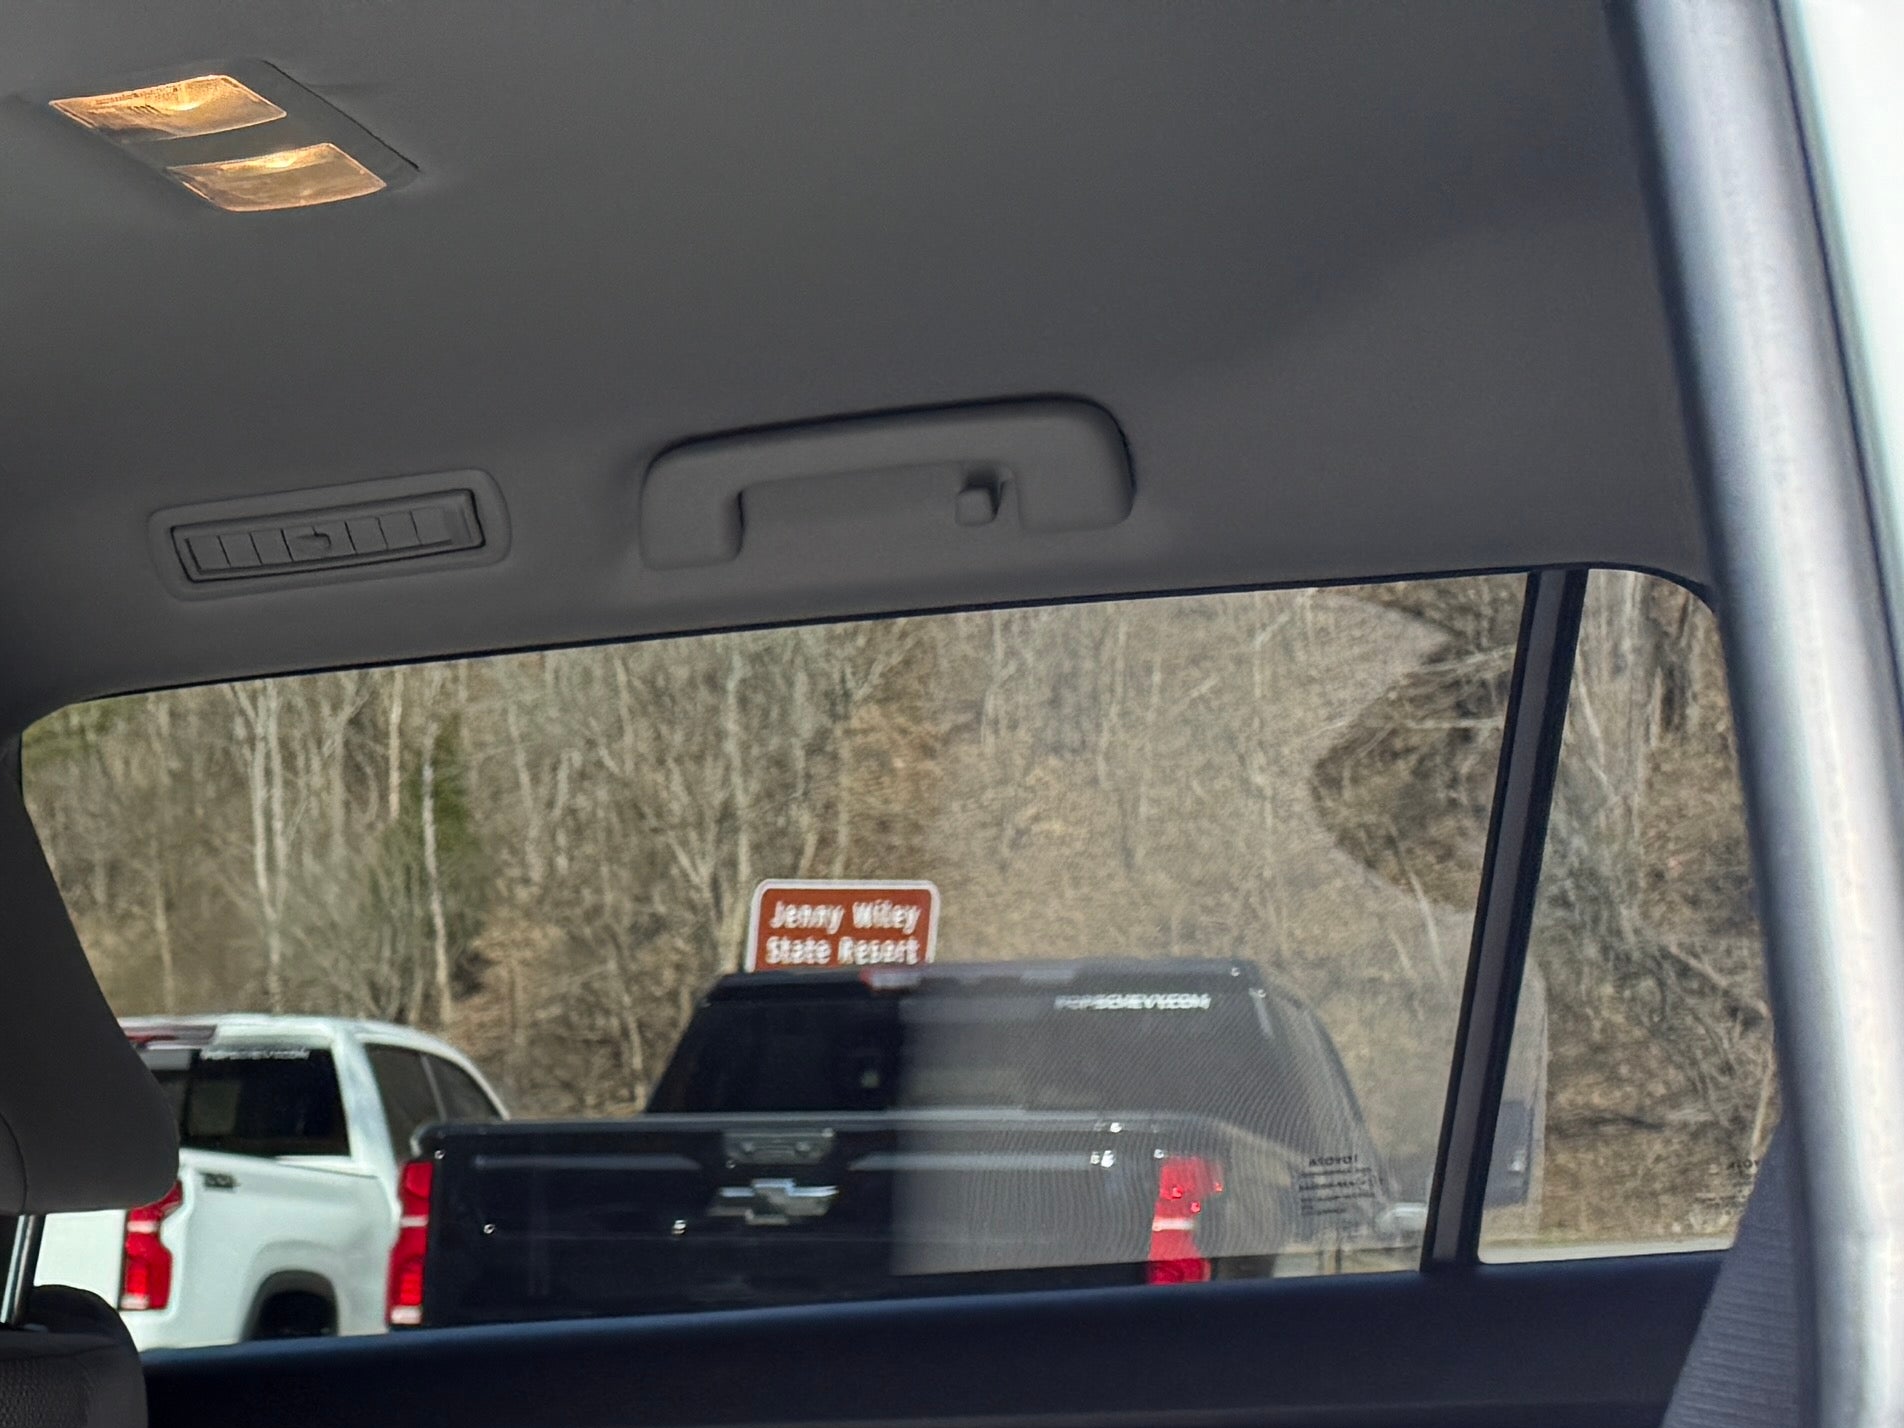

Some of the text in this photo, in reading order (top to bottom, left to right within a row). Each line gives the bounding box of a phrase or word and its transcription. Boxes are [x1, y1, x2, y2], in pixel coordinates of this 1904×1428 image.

[769, 899, 921, 935] Jenny Wiley
[765, 936, 920, 965] State Resort
